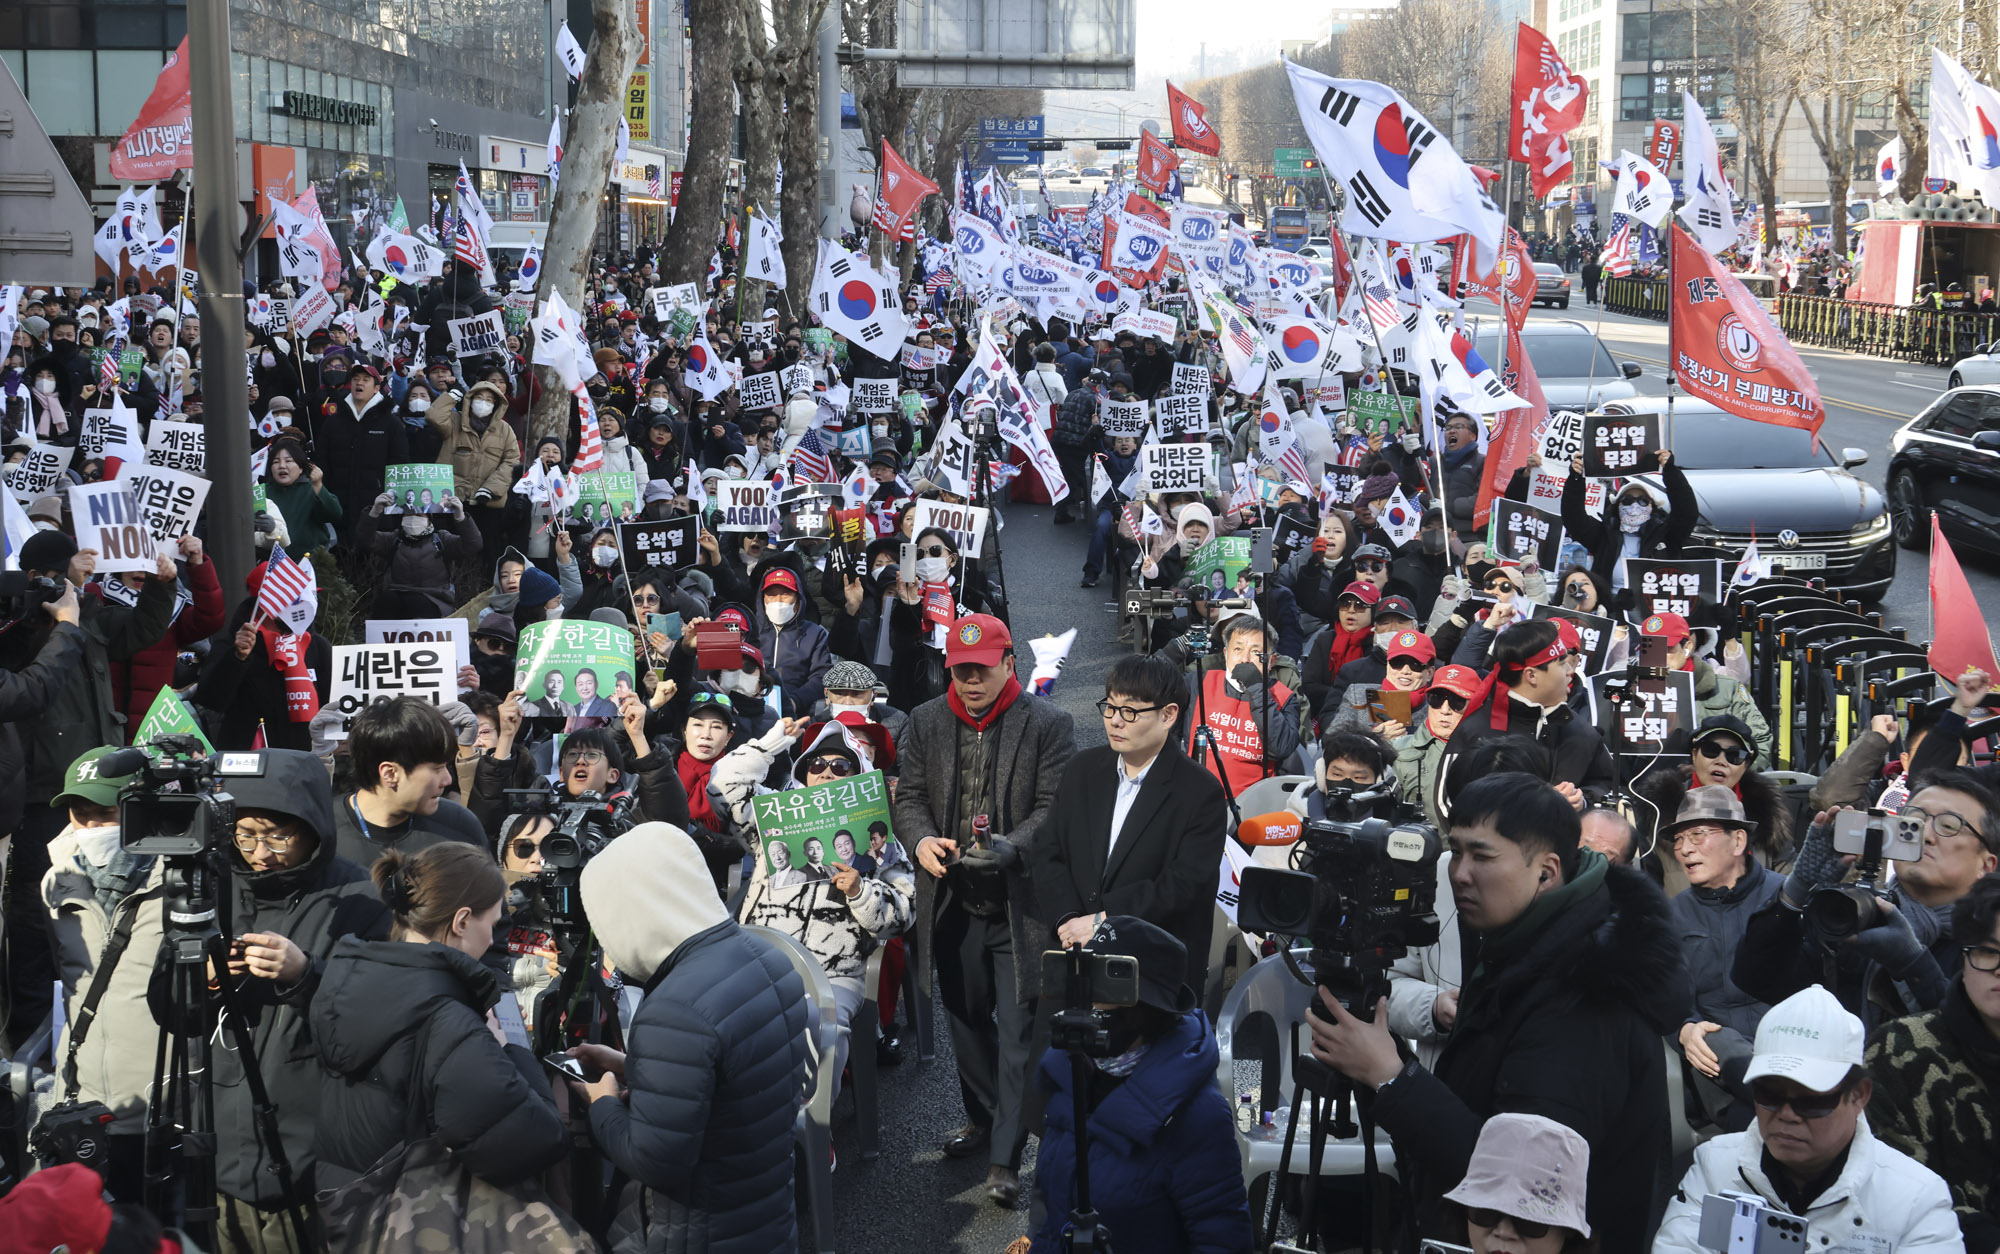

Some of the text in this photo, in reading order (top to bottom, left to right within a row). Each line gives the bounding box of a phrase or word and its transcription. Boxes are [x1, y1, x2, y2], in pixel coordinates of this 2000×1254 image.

[289, 91, 379, 126] STARBUCKS COFFEE
[1183, 219, 1214, 240] 해사
[1130, 238, 1160, 260] 해사
[458, 318, 495, 338] YOON
[460, 331, 500, 352] AGAIN
[1176, 366, 1209, 383] 내란은
[1678, 350, 1730, 392] 부정선거
[1733, 359, 1752, 370] ARMY
[741, 375, 774, 393] 내란은
[858, 383, 890, 396] 계엄은
[1174, 379, 1209, 395] 없었다
[1678, 371, 1699, 390] ELECTION
[1699, 386, 1723, 400] JUSTICE
[1731, 399, 1800, 417] ANTI-CORRUPTION
[741, 390, 776, 408] 없었다
[853, 396, 895, 409] 정당했다
[1160, 396, 1202, 416] 내란은
[1351, 391, 1415, 413] 자유한길단
[1107, 406, 1142, 419] 계엄은
[1000, 427, 1020, 441] KOREA
[1102, 418, 1146, 433] 정당했다
[1161, 414, 1204, 434] 없었다
[1595, 425, 1646, 448] 윤석열
[1149, 446, 1205, 467] 내란은
[1603, 450, 1638, 469] 무죄
[386, 465, 452, 480] 자유한길단
[1150, 467, 1206, 489] 없었다
[796, 514, 823, 531] 무죄
[928, 507, 975, 532] YOON
[1508, 512, 1550, 541] 윤석열
[636, 528, 684, 550] 윤석열
[646, 551, 677, 567] 무죄
[1795, 556, 1824, 568] 7118
[1642, 572, 1700, 596] 윤석열
[1652, 598, 1690, 618] 무죄
[341, 649, 444, 690] 내란은
[1208, 711, 1241, 731] 석열이
[1623, 717, 1668, 743] 무죄
[759, 775, 882, 823] 자유한길단
[1264, 824, 1299, 840] 연합뉴스TV
[1392, 840, 1422, 851] 연합뉴스TV
